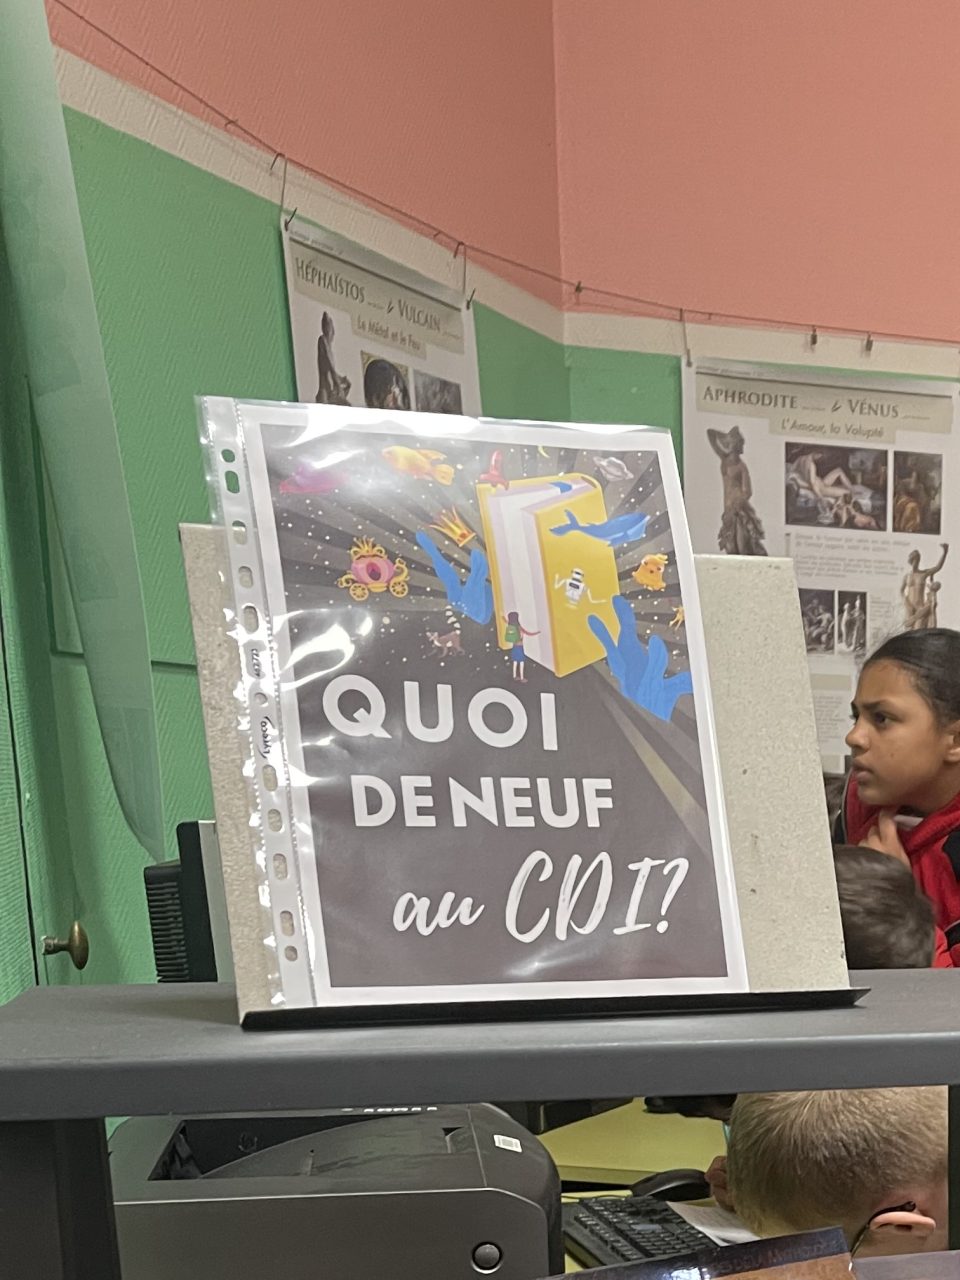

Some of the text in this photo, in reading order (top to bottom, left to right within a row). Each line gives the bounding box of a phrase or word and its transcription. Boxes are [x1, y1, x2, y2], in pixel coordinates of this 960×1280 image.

[295, 258, 441, 331] HÉPHAÏSTOS VULCAIN
[703, 386, 900, 418] APHRODITE VÉNUS
[322, 674, 559, 753] QUOI
[351, 774, 614, 828] DE NEUF
[392, 848, 690, 944] au CDI?
